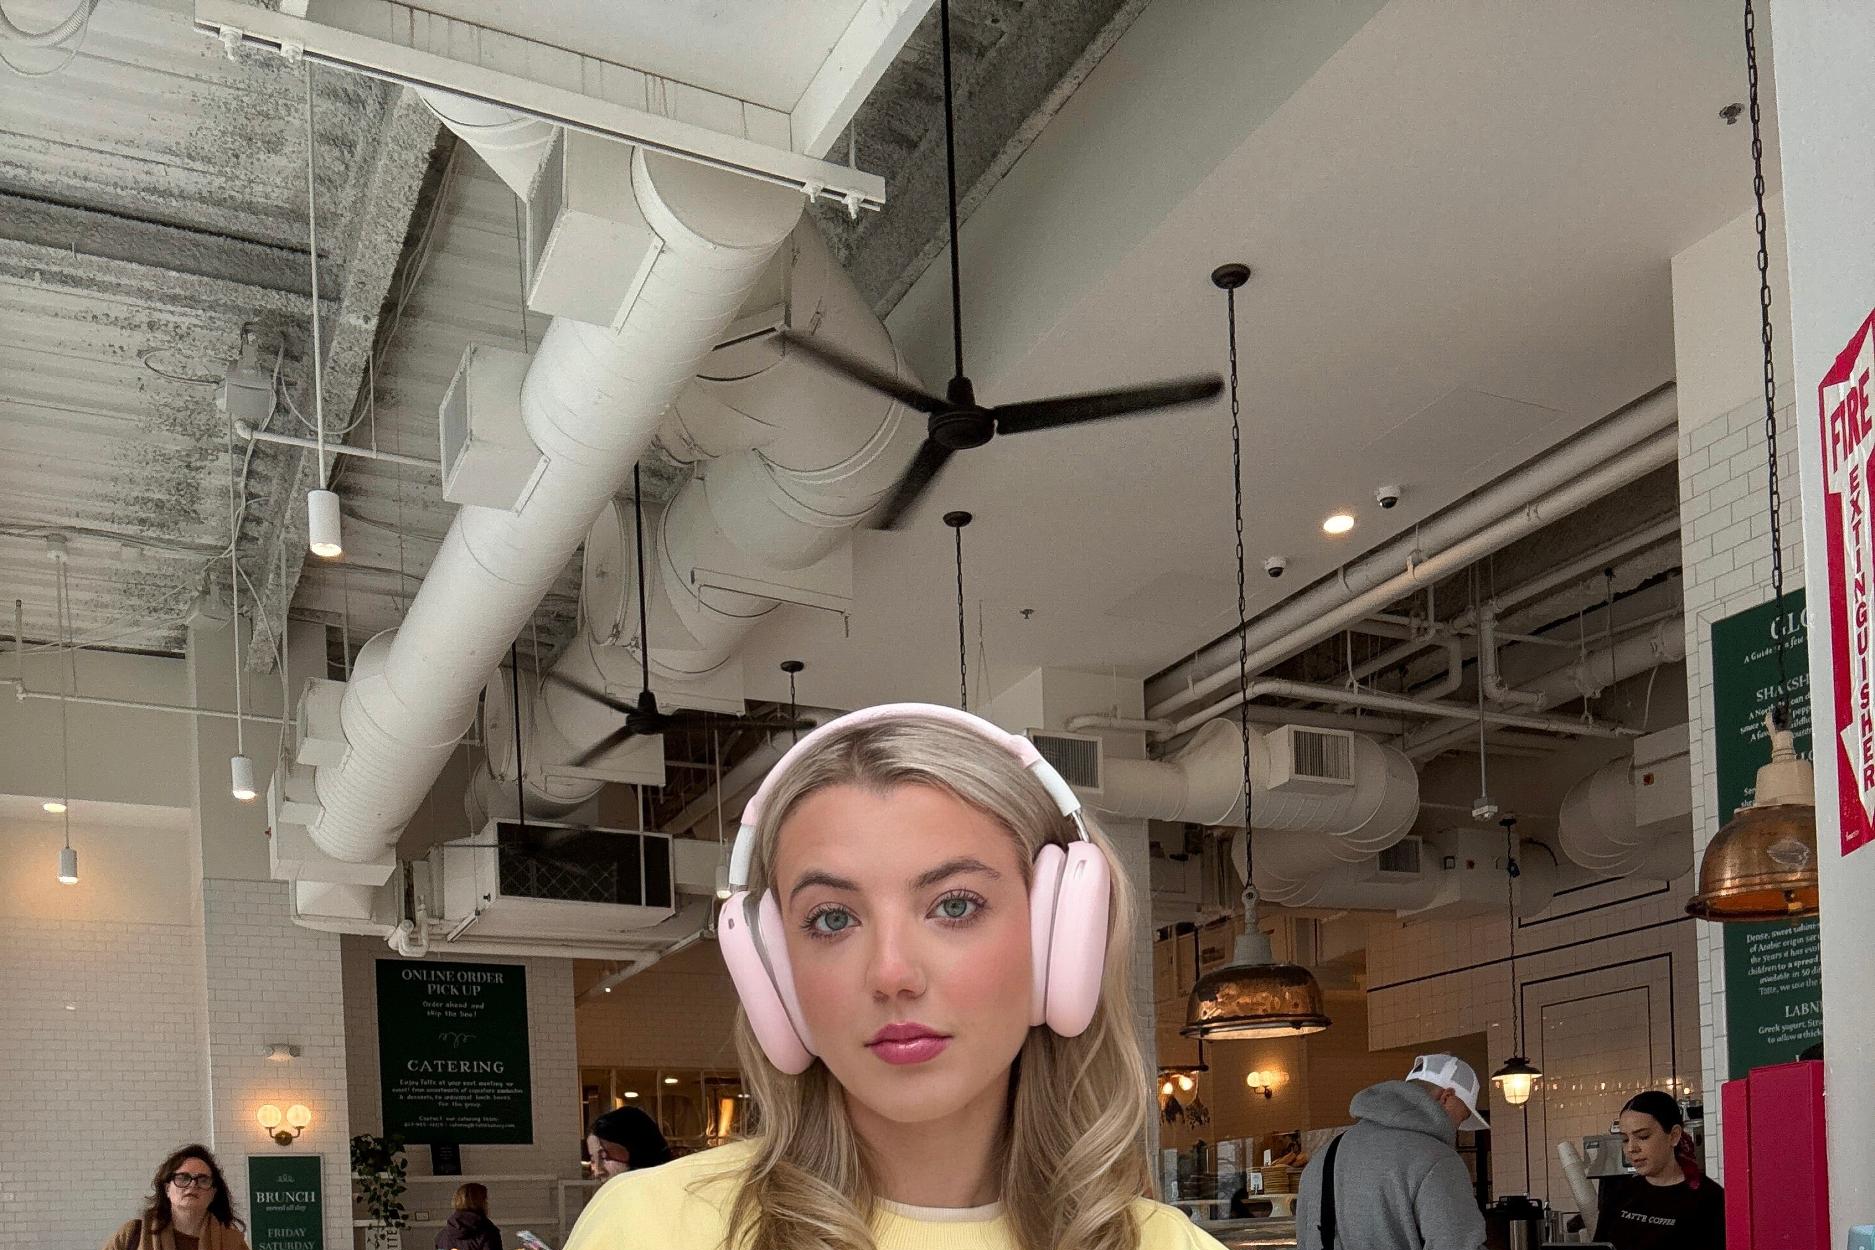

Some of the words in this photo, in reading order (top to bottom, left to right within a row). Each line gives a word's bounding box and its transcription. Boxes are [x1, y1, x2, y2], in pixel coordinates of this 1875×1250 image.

[1829, 366, 1872, 474] FIRE
[1850, 463, 1875, 793] EXTINGUISHER
[402, 968, 454, 982] ONLINE
[457, 970, 504, 984] ORDER
[428, 983, 459, 996] PICK
[462, 985, 481, 996] UP
[422, 1000, 442, 1008] Order
[1758, 1023, 1780, 1034] Greek
[407, 1059, 504, 1074] CATERING
[256, 1191, 316, 1203] BRUNCH
[1620, 1210, 1647, 1223] TATTE
[268, 1228, 306, 1238] FRIDAY
[259, 1240, 316, 1250] SATURDAY
